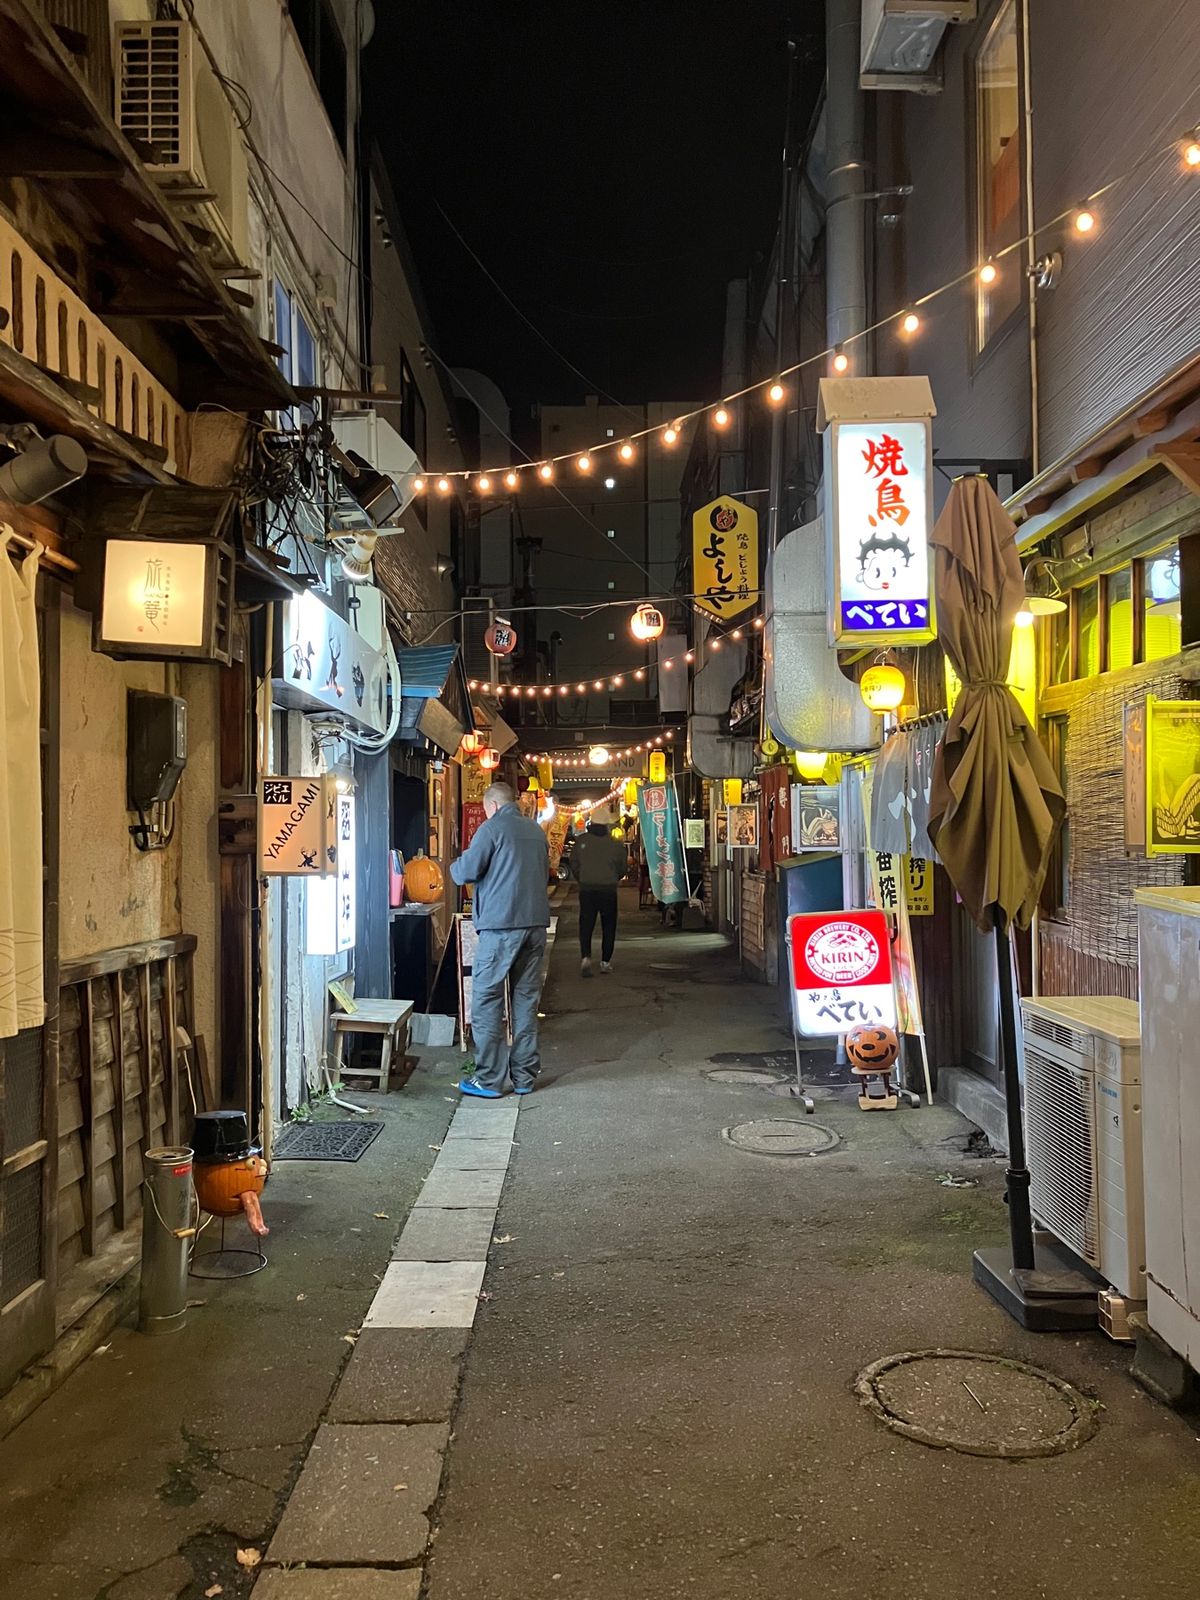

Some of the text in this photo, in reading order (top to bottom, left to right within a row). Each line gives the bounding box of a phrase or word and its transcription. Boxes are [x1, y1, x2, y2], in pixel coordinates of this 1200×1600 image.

[861, 434, 911, 528] 焼鳥
[703, 532, 735, 610] よしや
[847, 603, 927, 627] べてい
[264, 783, 291, 794] ジビエ
[266, 794, 289, 803] バル
[264, 783, 321, 860] YAMAGAMI
[821, 951, 864, 965] KIRIN
[816, 1000, 883, 1023] べてい
